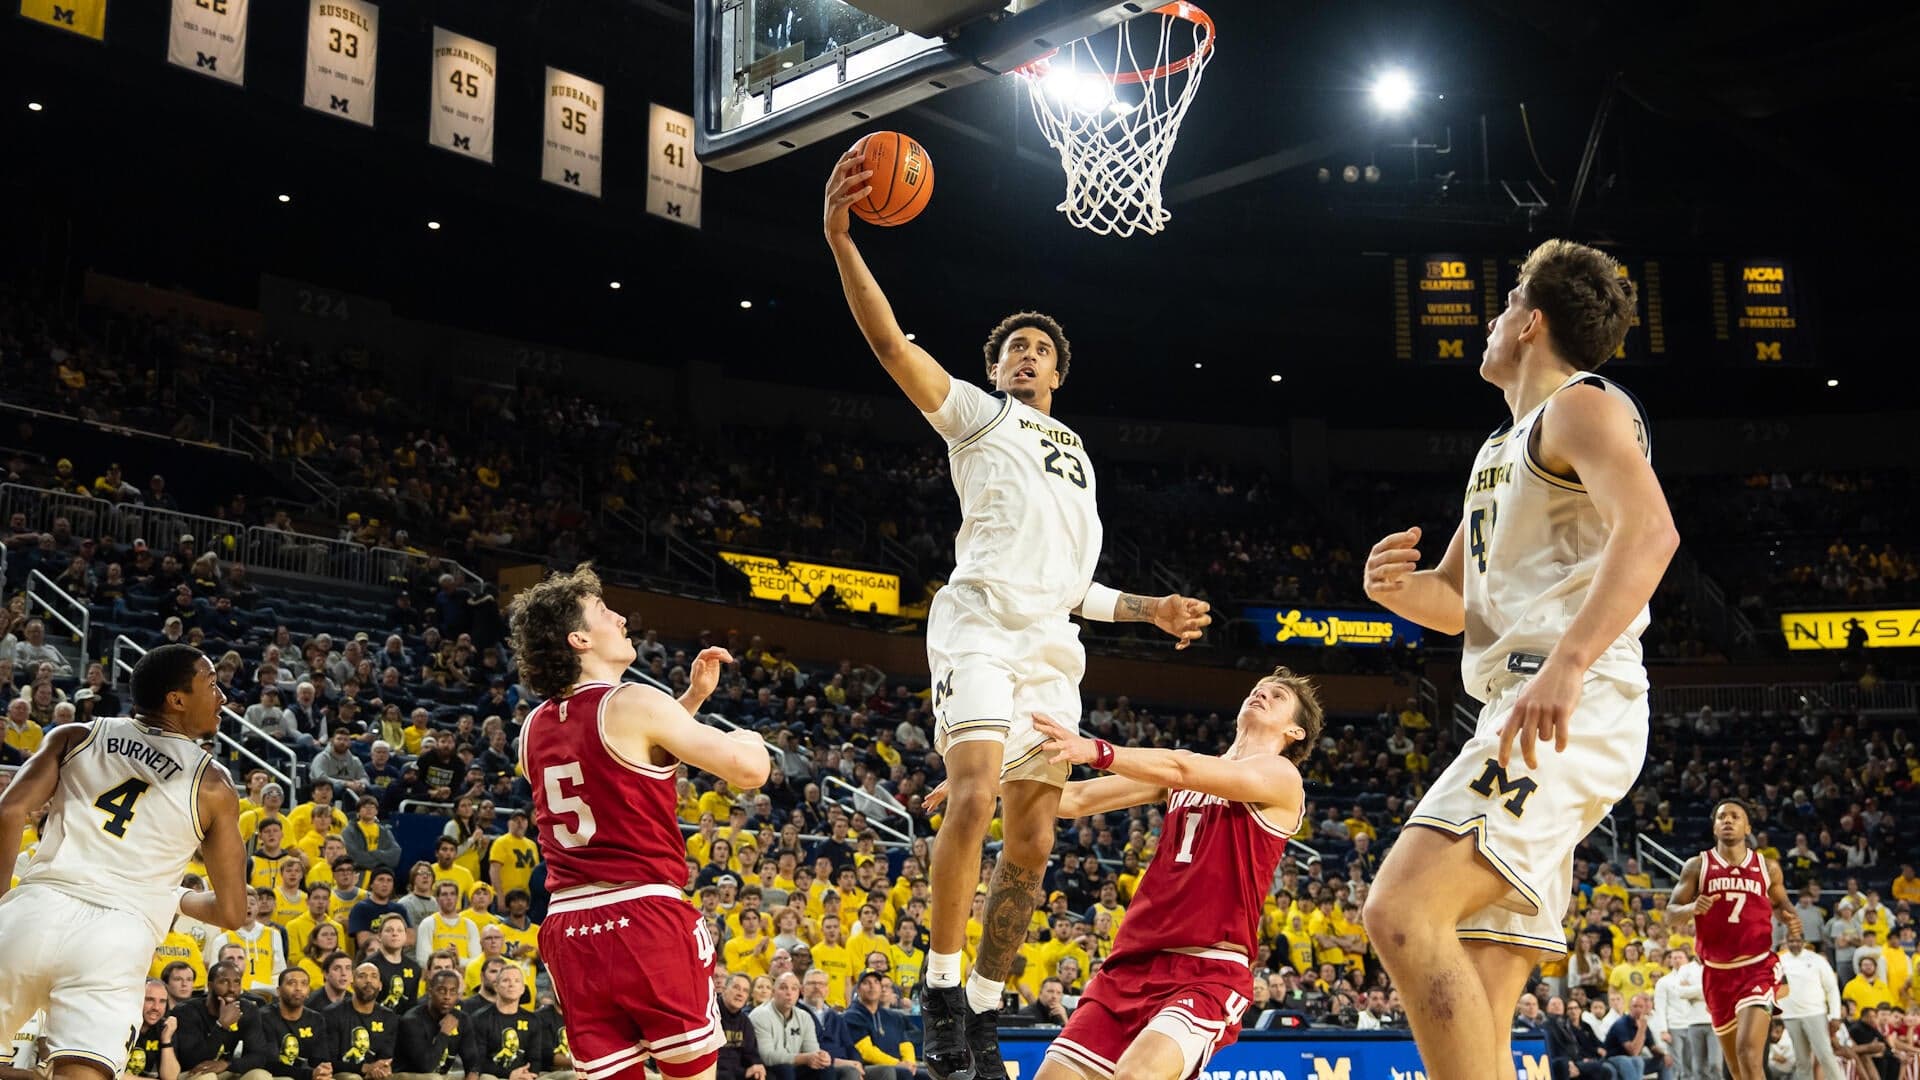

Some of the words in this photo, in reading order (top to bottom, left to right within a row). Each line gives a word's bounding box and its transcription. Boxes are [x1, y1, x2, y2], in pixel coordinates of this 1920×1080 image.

[53, 5, 75, 25] M
[319, 4, 369, 32] RUSSELL
[328, 27, 359, 58] 33
[196, 51, 217, 71] M
[450, 70, 479, 98] 45
[330, 95, 349, 114] M
[551, 85, 598, 112] HUBBARD
[561, 107, 587, 135] 35
[453, 132, 471, 150] M
[664, 143, 685, 169] 41
[904, 141, 922, 187] ELITE
[563, 169, 581, 186] M
[666, 201, 682, 218] M
[1743, 267, 1785, 281] NCAA
[1420, 279, 1475, 291] CHAMPIONS
[1747, 282, 1782, 294] FINALS
[1438, 339, 1465, 359] M
[1755, 341, 1783, 361] M
[1040, 438, 1087, 489] 23
[750, 575, 798, 593] CREDIT
[808, 568, 827, 581] OF
[830, 571, 897, 592] MICHIGAN
[106, 737, 184, 781] BURNETT
[1468, 757, 1539, 819] M
[94, 776, 151, 840] 4
[543, 761, 597, 850] 5
[1174, 812, 1203, 863] 1
[512, 848, 537, 869] M
[1707, 876, 1762, 897] INDIANA
[1725, 891, 1748, 924] 7
[298, 1026, 314, 1039] M
[371, 1020, 385, 1032] M
[145, 1039, 160, 1051] M
